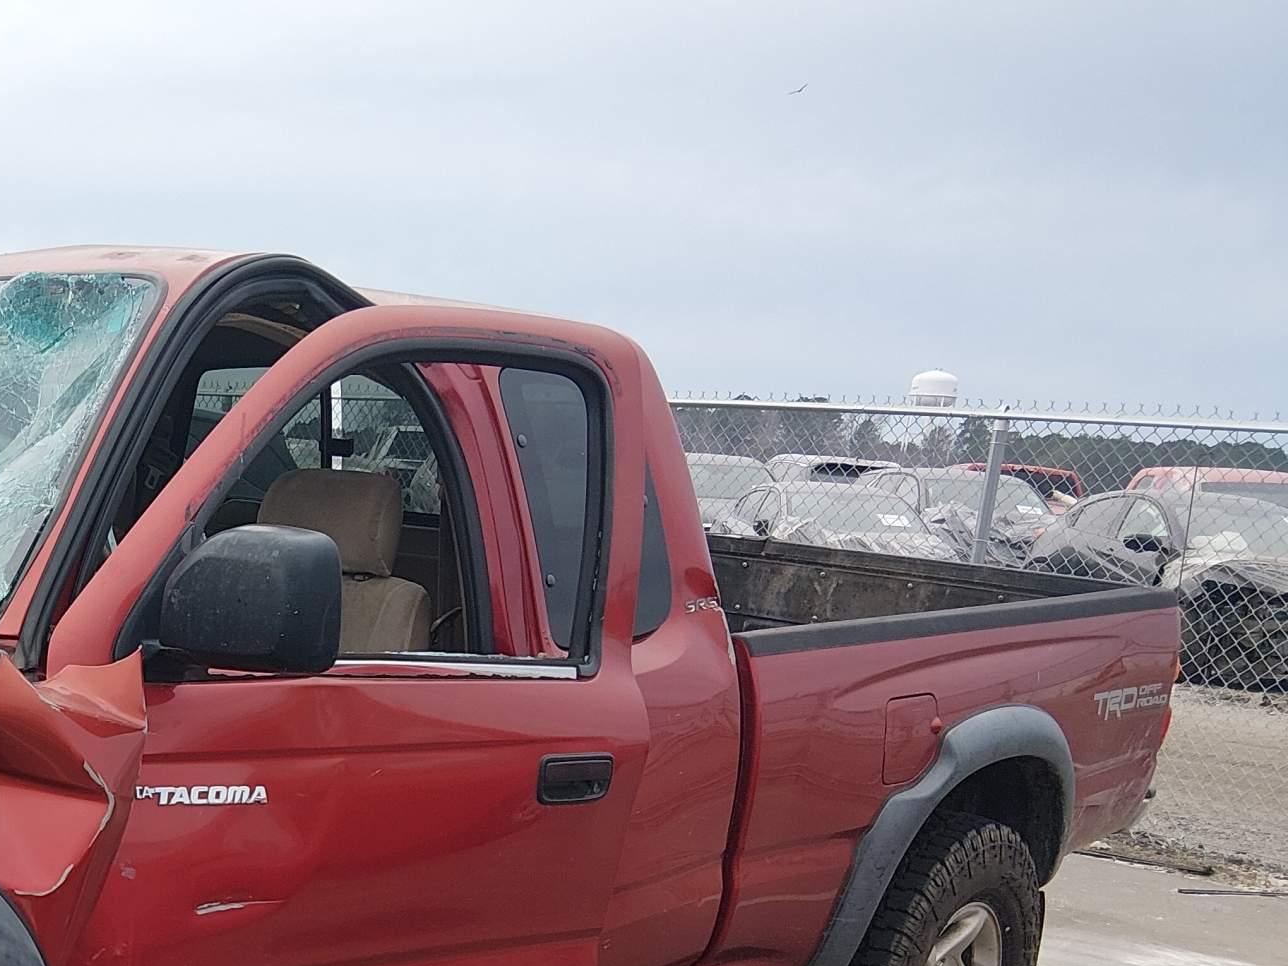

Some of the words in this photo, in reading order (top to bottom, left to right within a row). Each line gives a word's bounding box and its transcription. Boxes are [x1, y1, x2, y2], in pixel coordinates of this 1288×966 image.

[1139, 683, 1163, 695] OFF
[1094, 687, 1137, 720] TRD
[1137, 694, 1168, 708] ROAD
[155, 785, 268, 805] TACOMA
